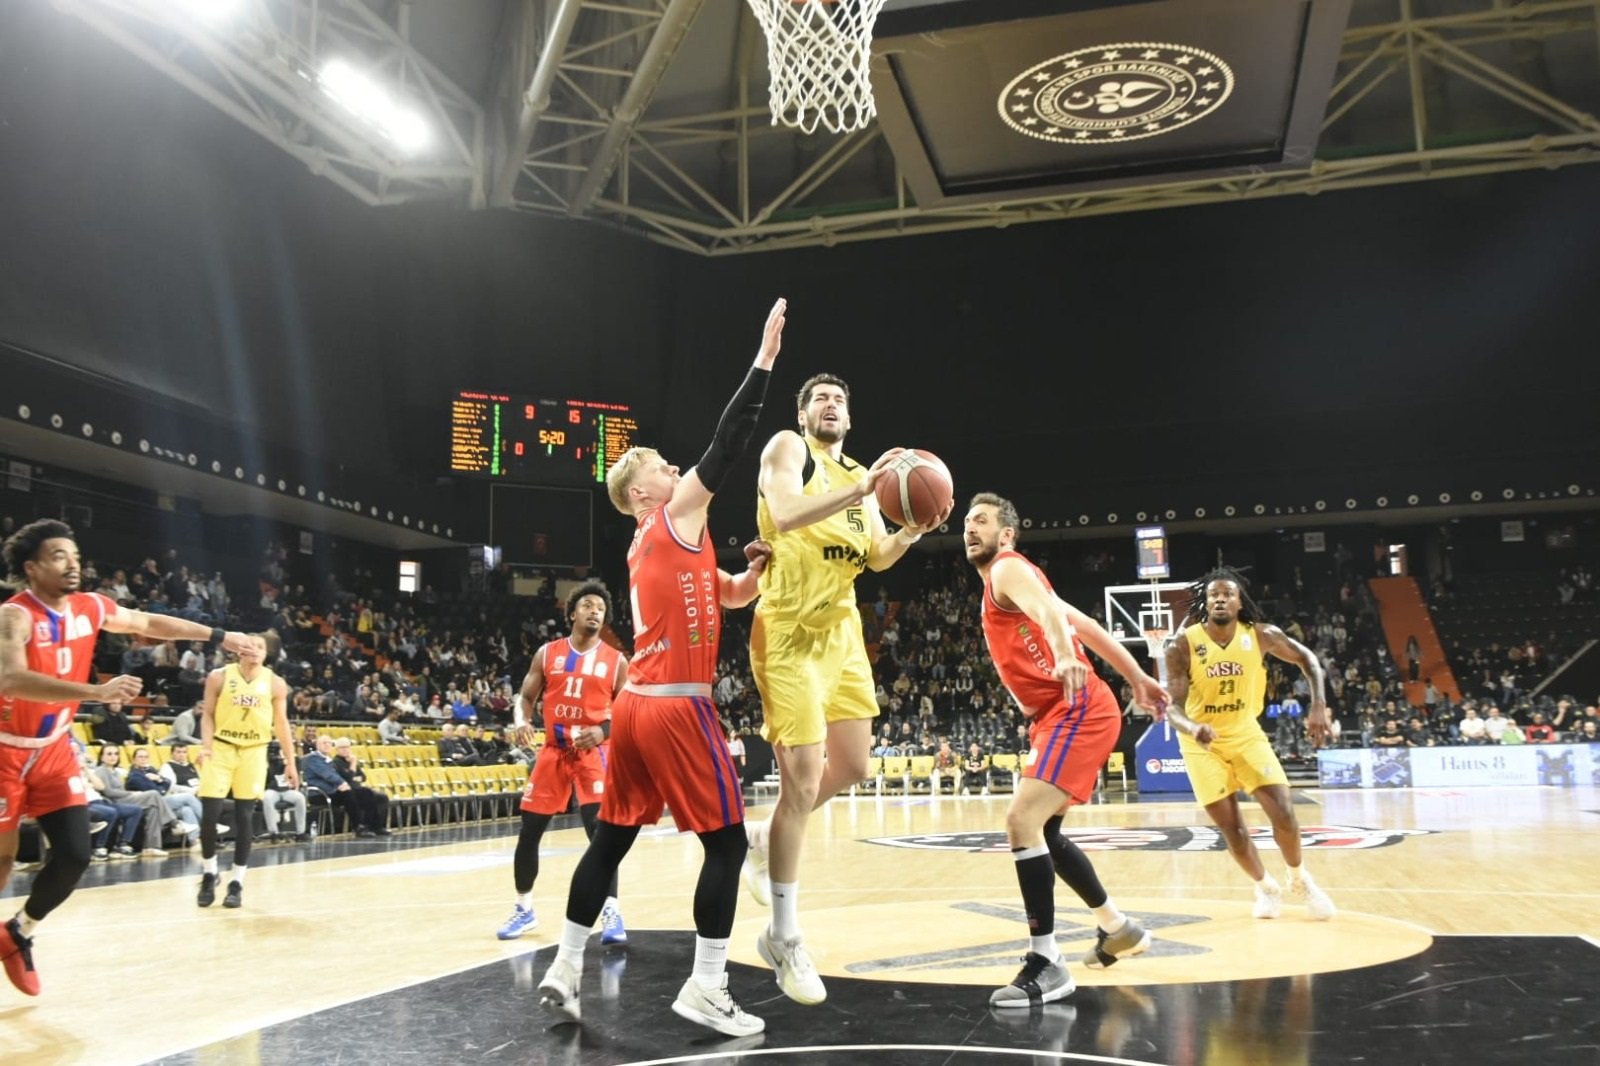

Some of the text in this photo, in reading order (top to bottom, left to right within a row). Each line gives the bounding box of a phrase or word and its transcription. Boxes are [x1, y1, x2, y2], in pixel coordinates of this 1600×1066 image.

[525, 405, 535, 420] 9
[569, 409, 581, 424] 15
[539, 430, 565, 446] 5:20
[515, 442, 524, 456] 0
[847, 508, 865, 534] 5
[681, 572, 698, 628] LOTUS
[703, 571, 715, 625] LOTUS
[56, 647, 72, 675] 0
[1023, 635, 1052, 676] LOTUS
[1206, 661, 1244, 678] MSK
[563, 676, 583, 699] 11
[1219, 680, 1235, 695] 23
[241, 707, 250, 722] 7
[220, 729, 261, 740] mersin
[1441, 756, 1506, 770] Haus 8
